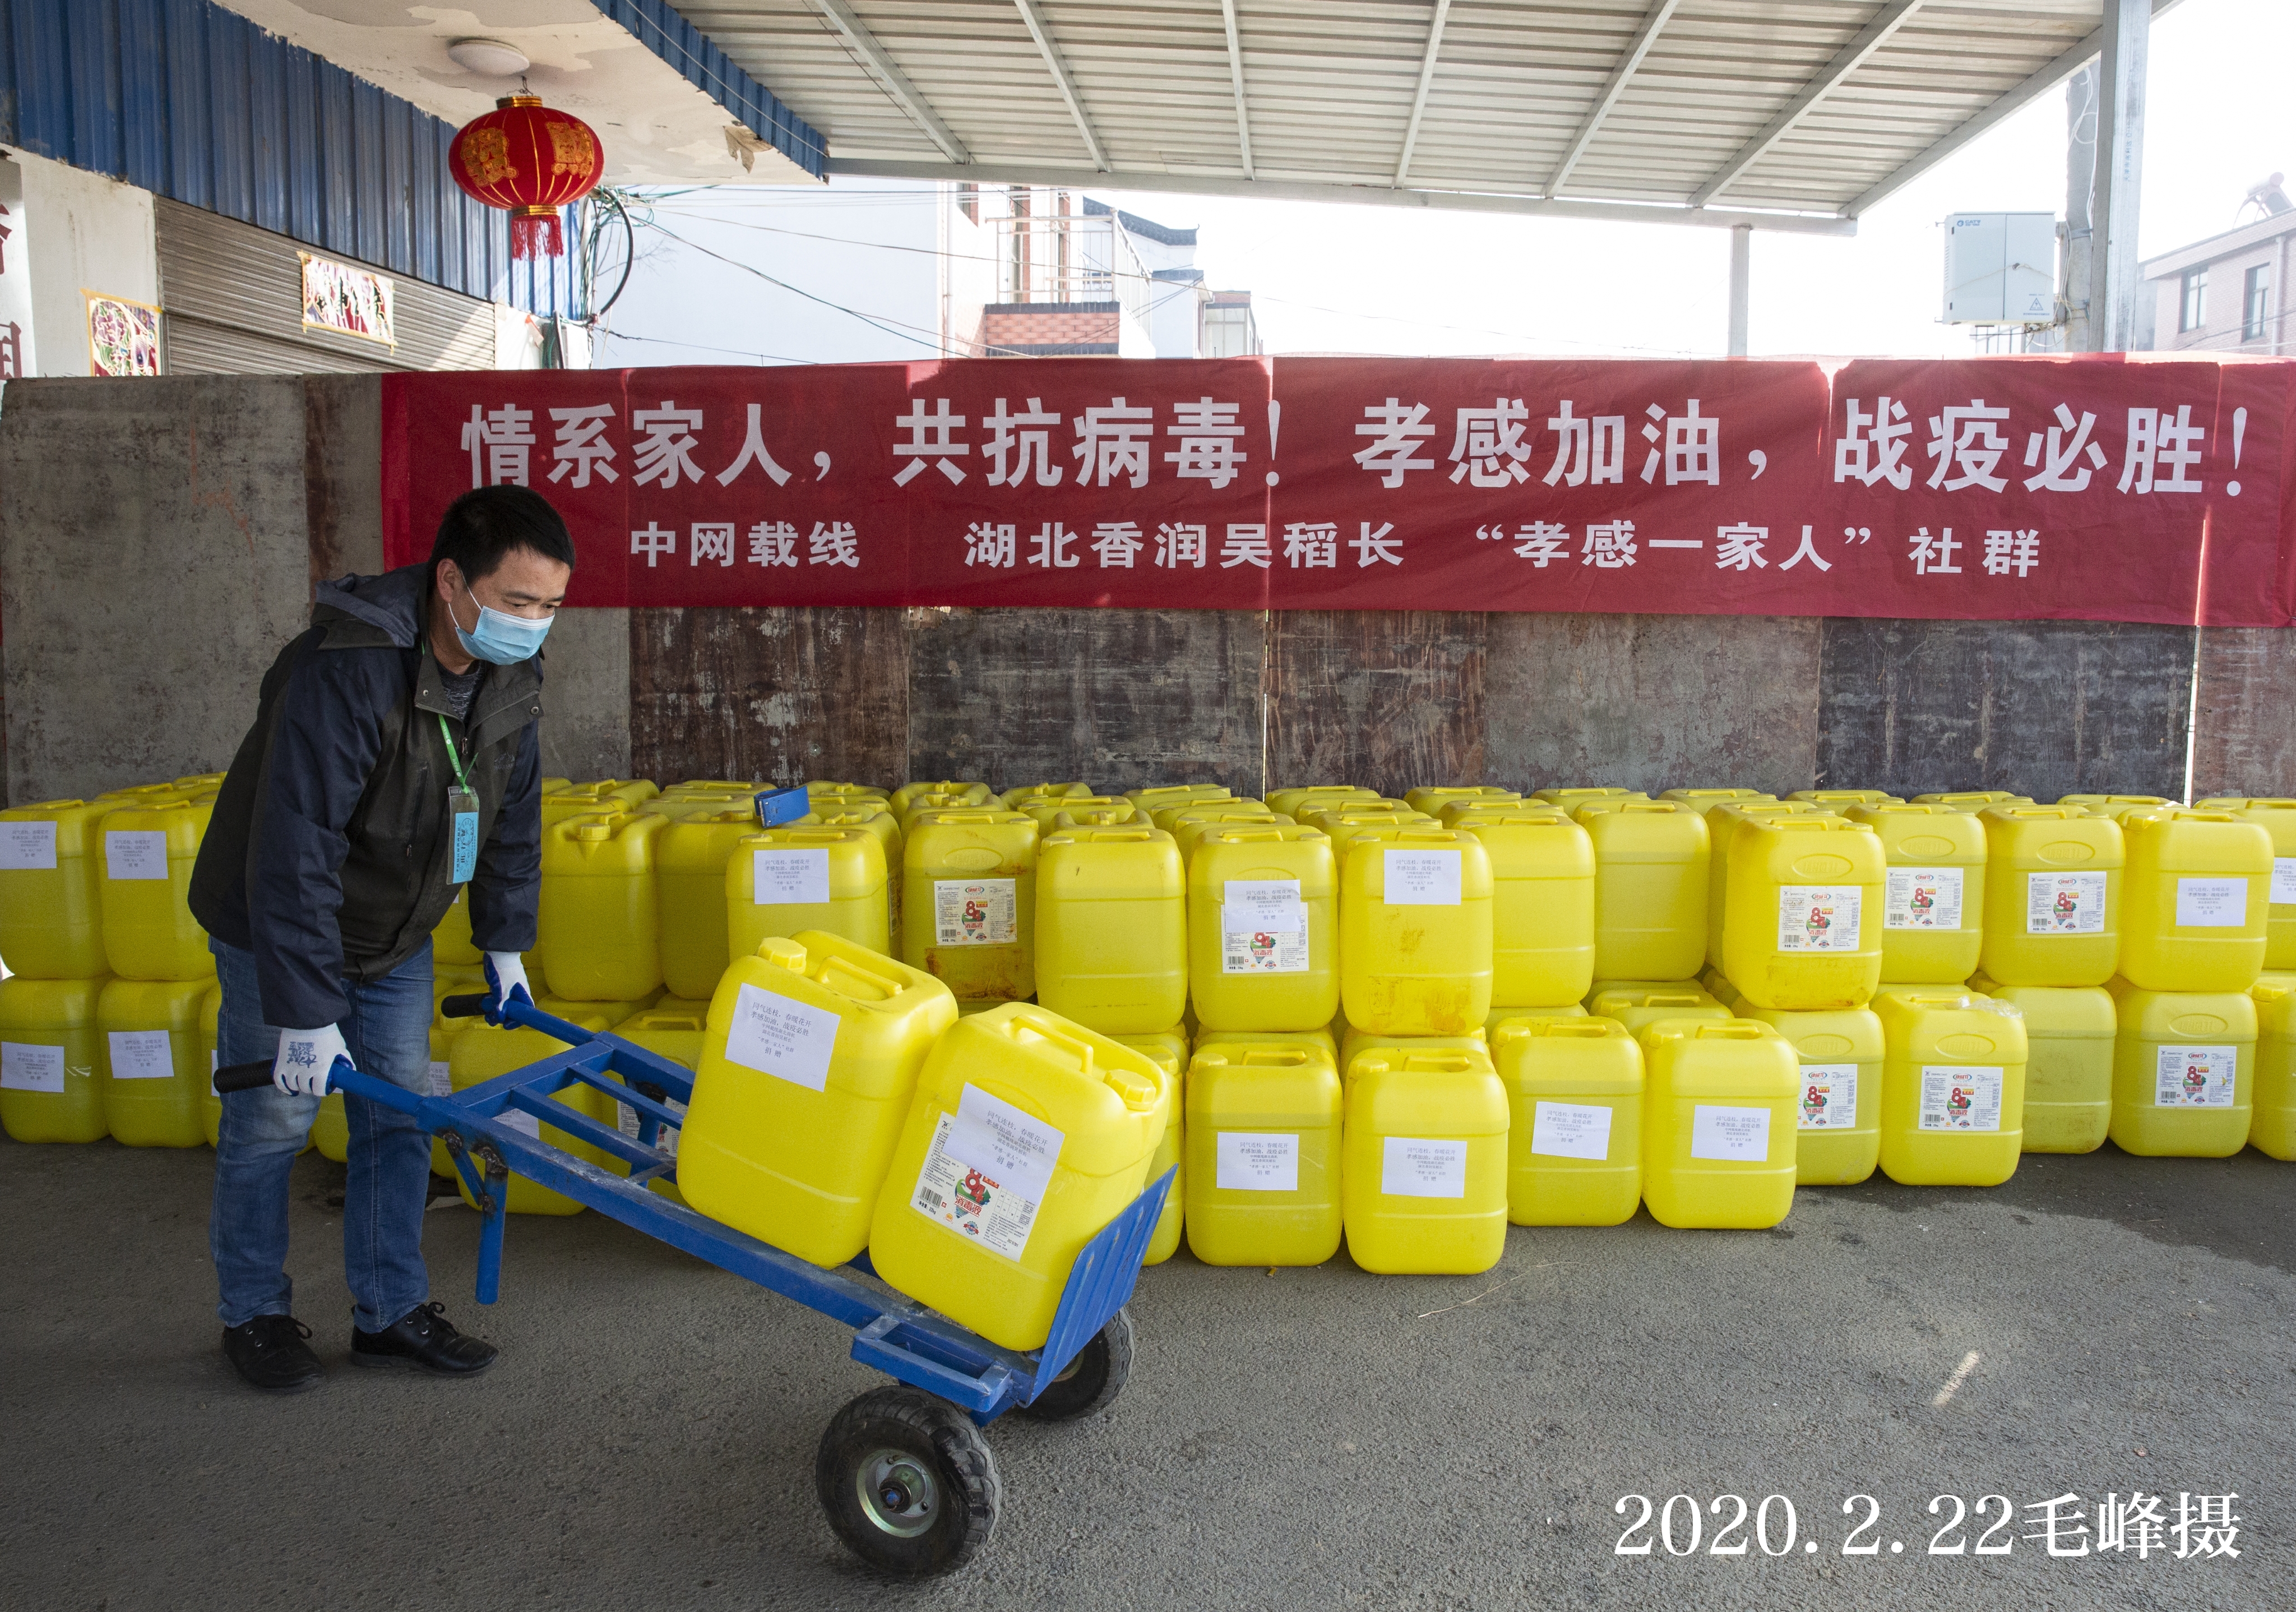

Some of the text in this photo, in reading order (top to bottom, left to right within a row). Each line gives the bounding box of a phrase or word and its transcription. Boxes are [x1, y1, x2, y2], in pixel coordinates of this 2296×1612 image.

[631, 521, 860, 567] 中网载线
[964, 521, 1404, 568] 湖北香润吴稻长
[955, 1194, 983, 1216] 消毒液
